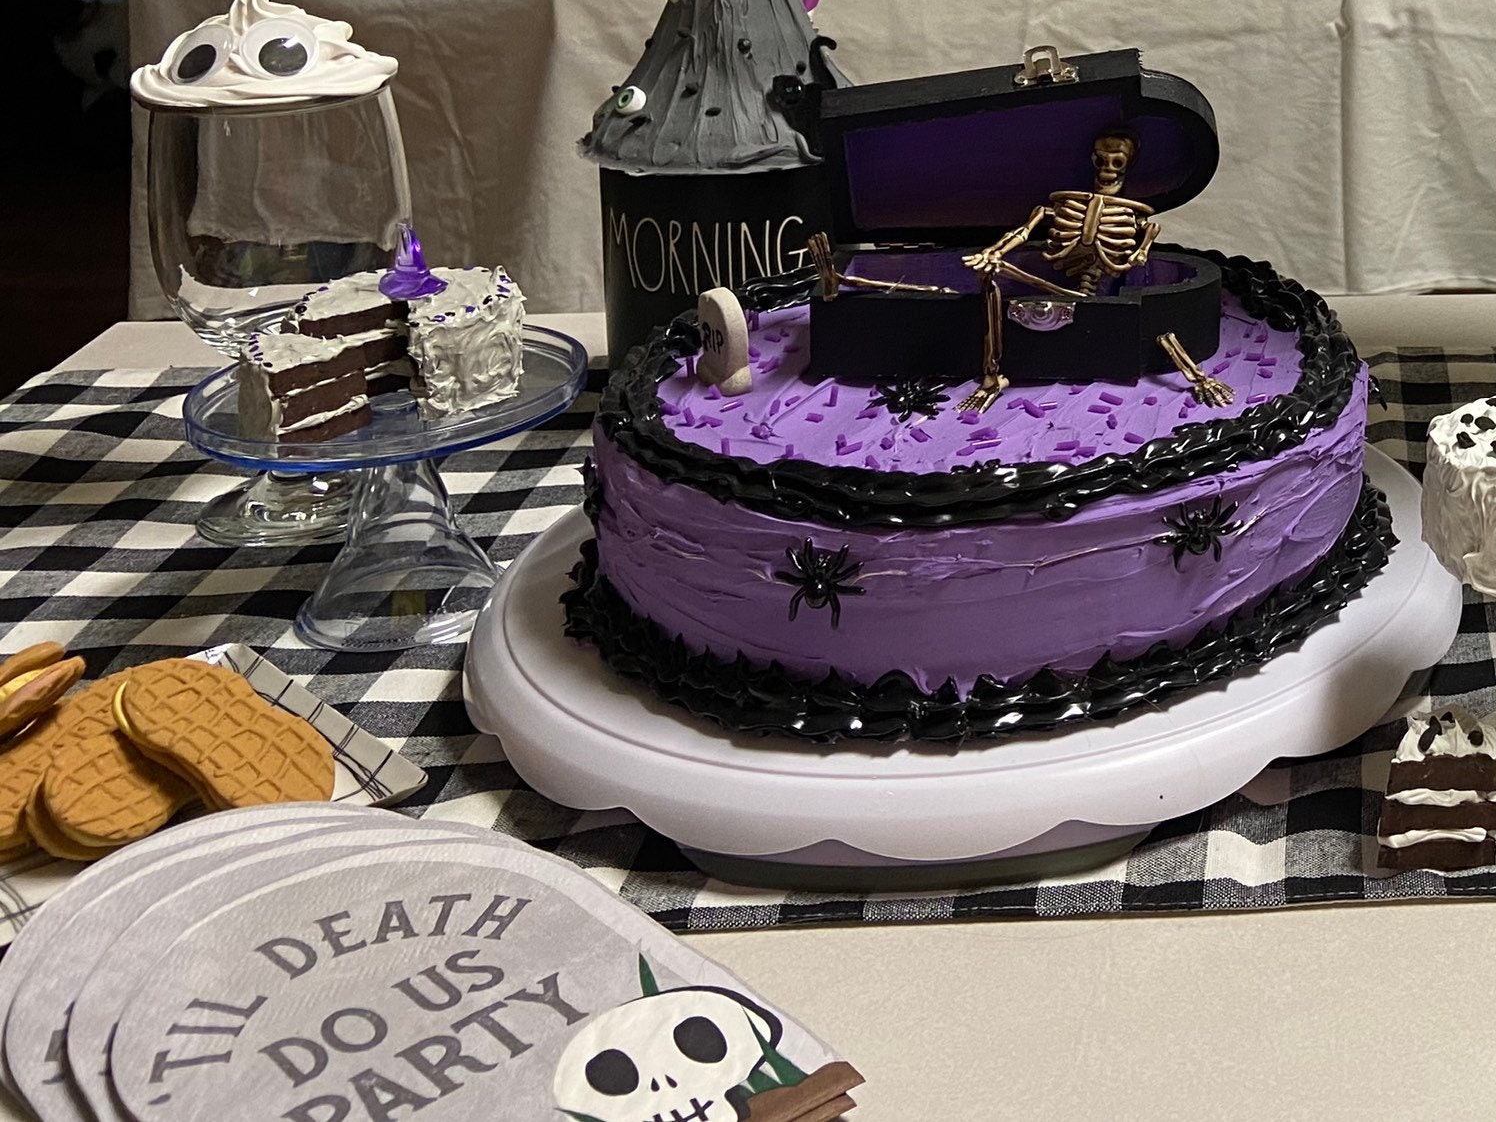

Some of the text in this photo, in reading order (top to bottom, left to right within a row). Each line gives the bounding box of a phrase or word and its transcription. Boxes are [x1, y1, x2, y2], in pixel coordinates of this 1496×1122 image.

[606, 206, 809, 296] MORNING
[702, 321, 724, 355] RIP
[254, 893, 532, 980] DEATH
[258, 949, 505, 1088] DO US
